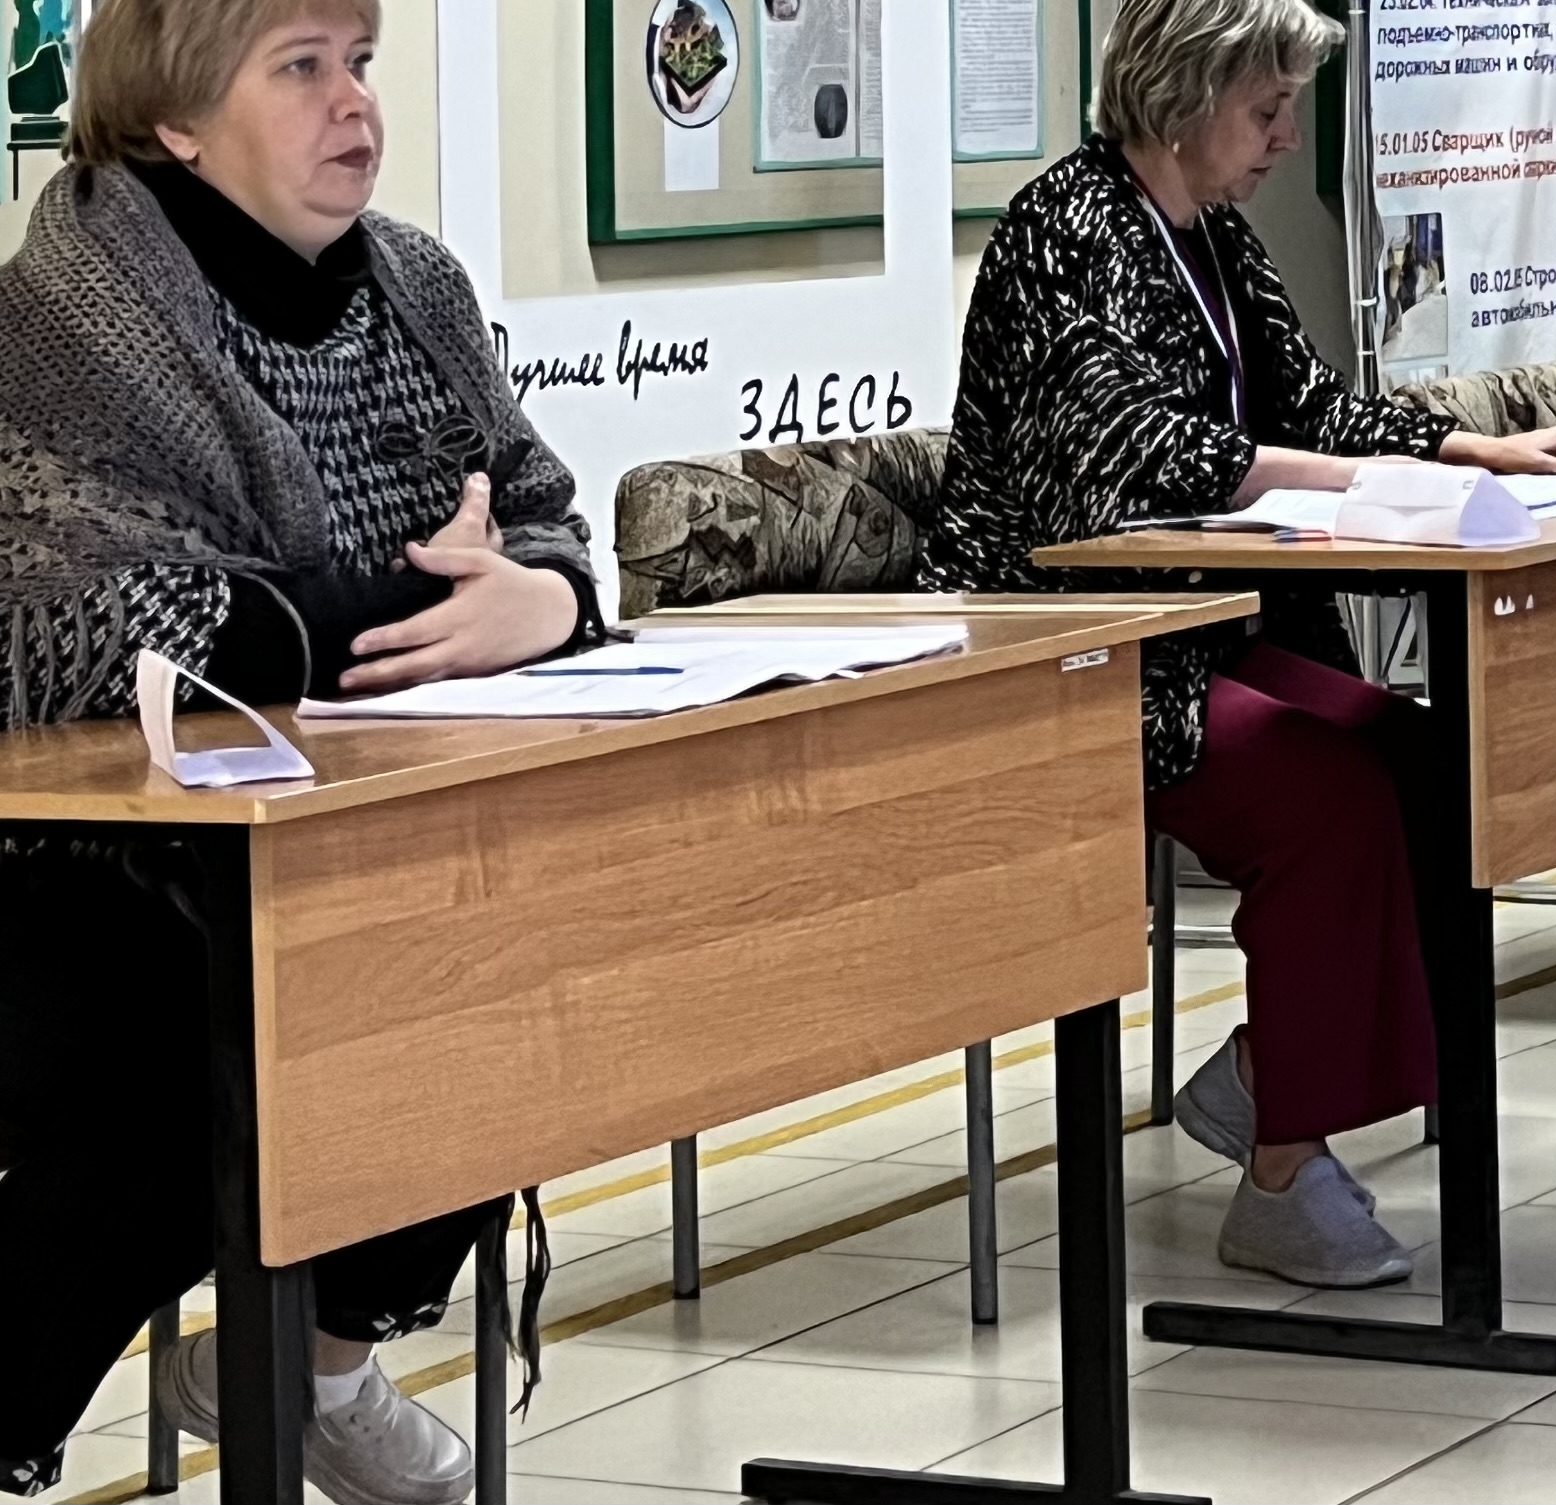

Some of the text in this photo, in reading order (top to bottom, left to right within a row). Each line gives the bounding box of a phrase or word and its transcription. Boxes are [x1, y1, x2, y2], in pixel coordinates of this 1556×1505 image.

[1507, 56, 1517, 71] и
[1432, 128, 1504, 155] Сварщик
[739, 371, 912, 444] ЗДЕСЬ
